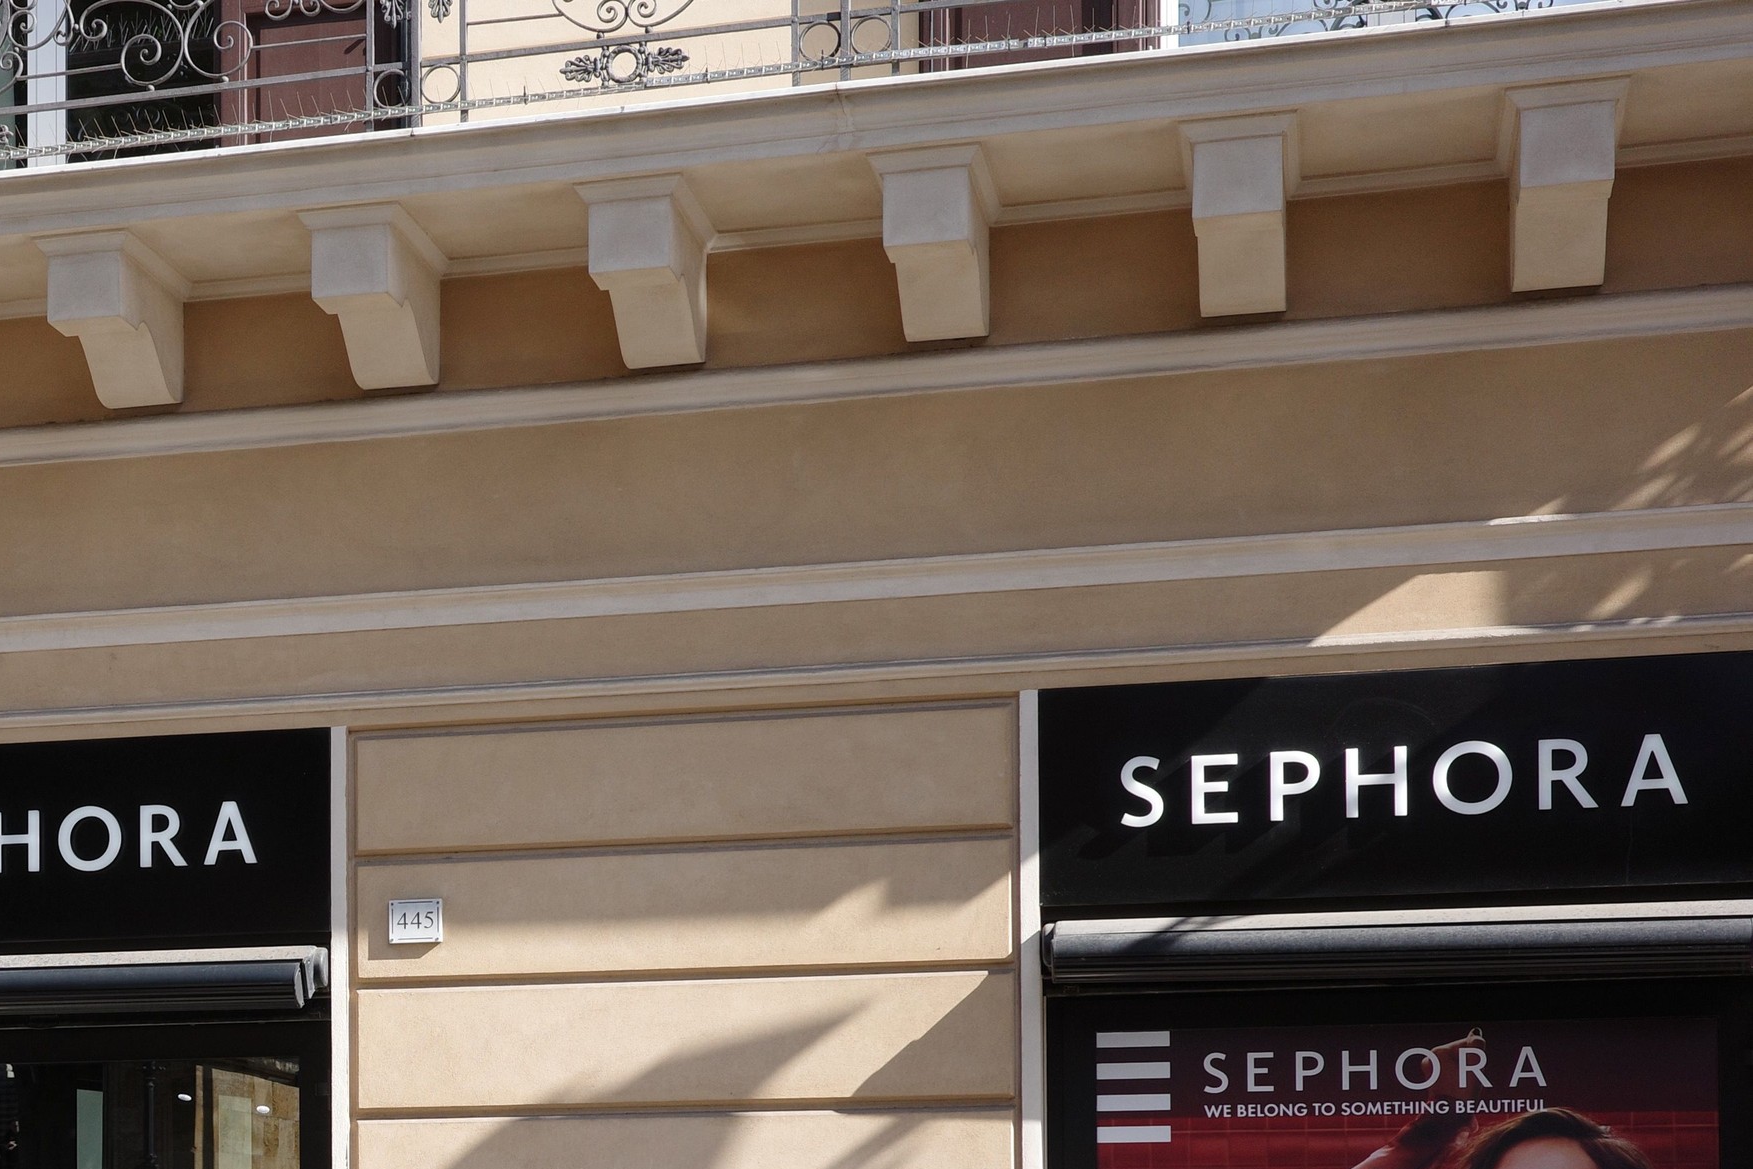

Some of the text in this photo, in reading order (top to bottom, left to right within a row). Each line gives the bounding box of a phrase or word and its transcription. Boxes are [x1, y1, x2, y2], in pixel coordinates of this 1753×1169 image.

[1119, 733, 1689, 828] SEPHORA
[396, 911, 434, 929] 445
[1203, 1046, 1547, 1094] SEPHORA
[1204, 1098, 1548, 1118] WE BELONG TO SOMETHING BEAUTIFUL
